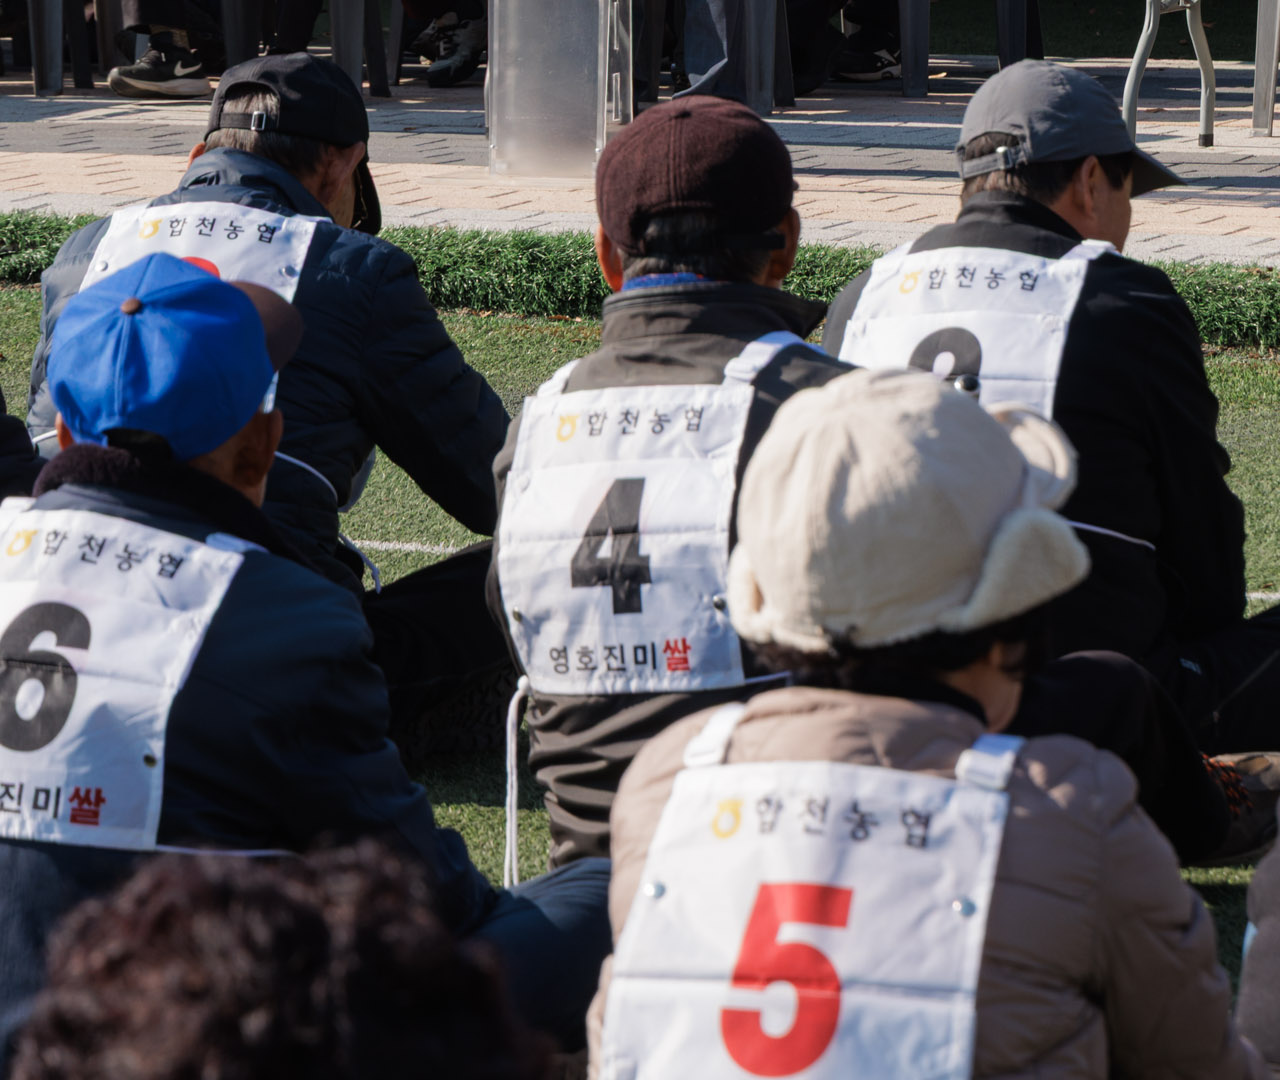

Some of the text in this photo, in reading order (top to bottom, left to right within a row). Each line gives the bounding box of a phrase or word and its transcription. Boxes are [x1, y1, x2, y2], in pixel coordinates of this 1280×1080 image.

[169, 216, 278, 244] 합천농협
[927, 264, 1040, 293] 합천농협
[587, 405, 705, 437] 합천농협
[43, 528, 184, 580] 합천농협
[571, 476, 653, 615] 4
[549, 637, 692, 675] 영호진미쌀
[754, 795, 933, 849] 합천농협
[720, 882, 854, 1079] 5
